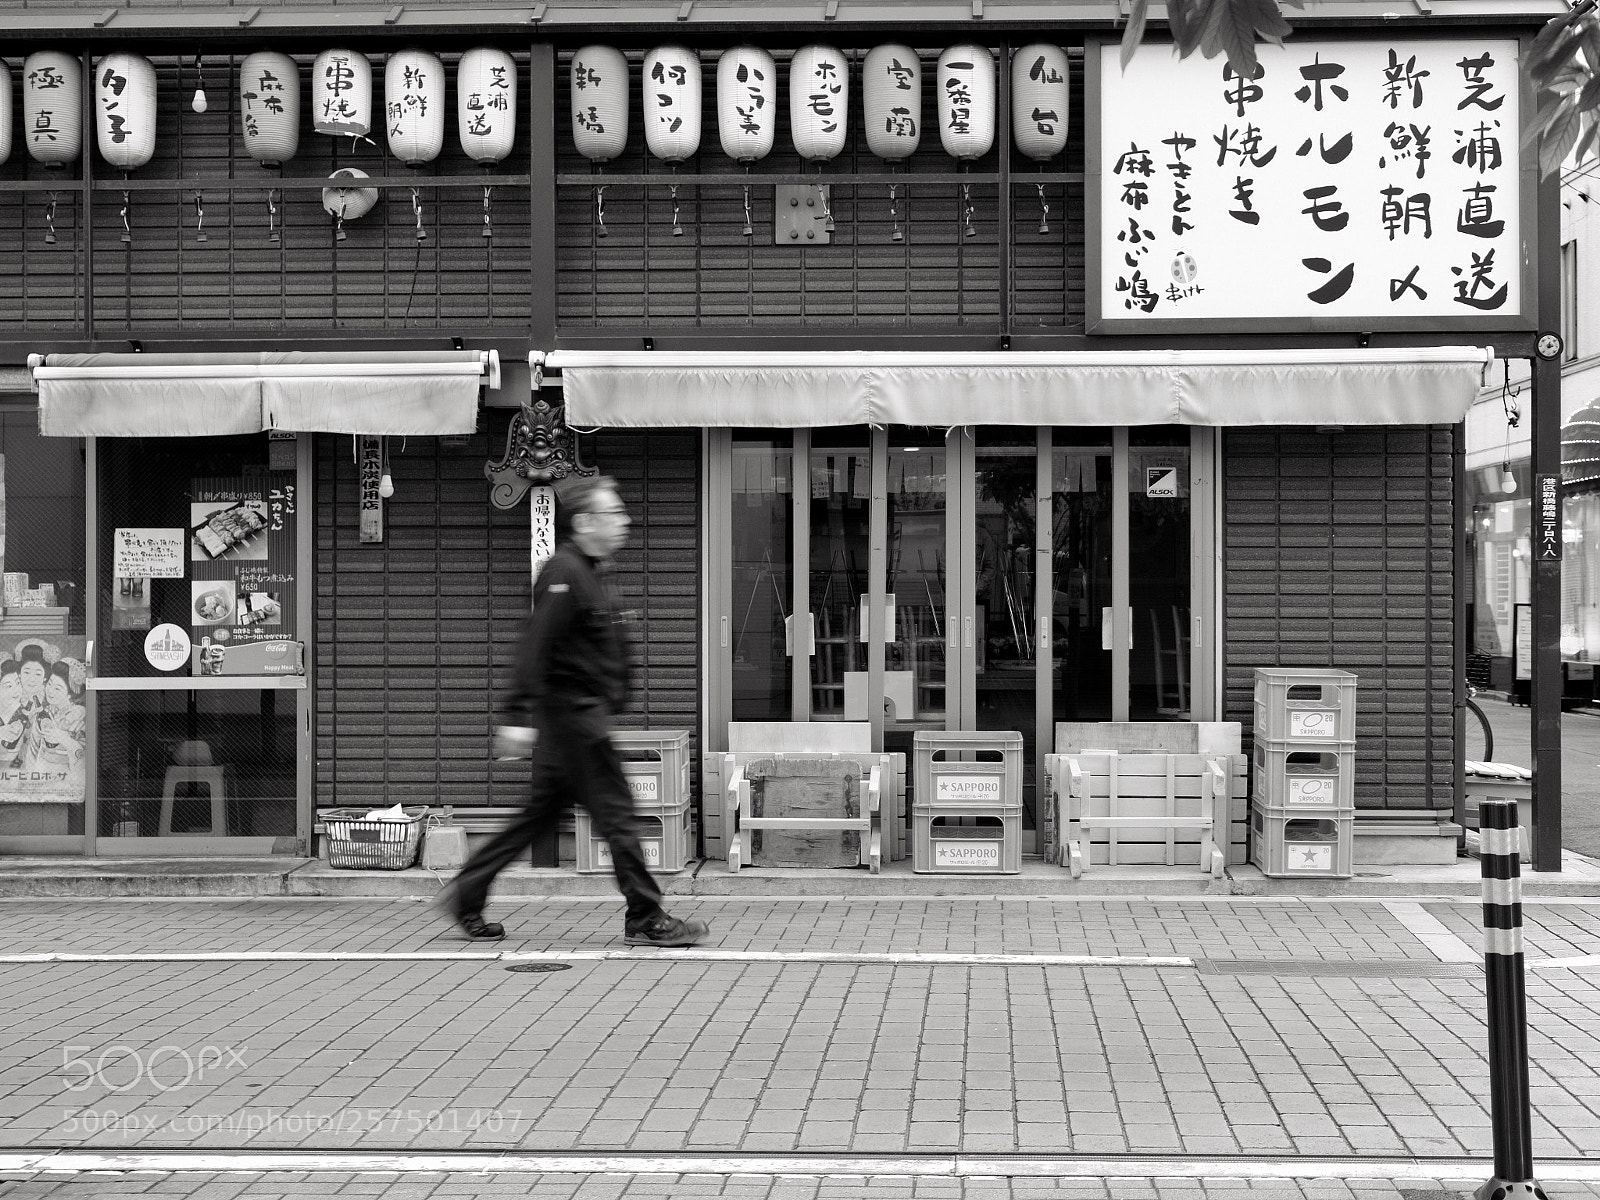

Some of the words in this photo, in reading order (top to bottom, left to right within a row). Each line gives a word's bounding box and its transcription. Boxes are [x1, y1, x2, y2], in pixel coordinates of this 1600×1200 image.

[806, 59, 842, 133] ホルモン
[1213, 60, 1278, 225] 串焼き
[1295, 52, 1355, 304] ホルモン
[1451, 52, 1508, 310] 芝浦直送
[951, 782, 998, 792] SAPPORO
[950, 848, 997, 858] SAPPORO
